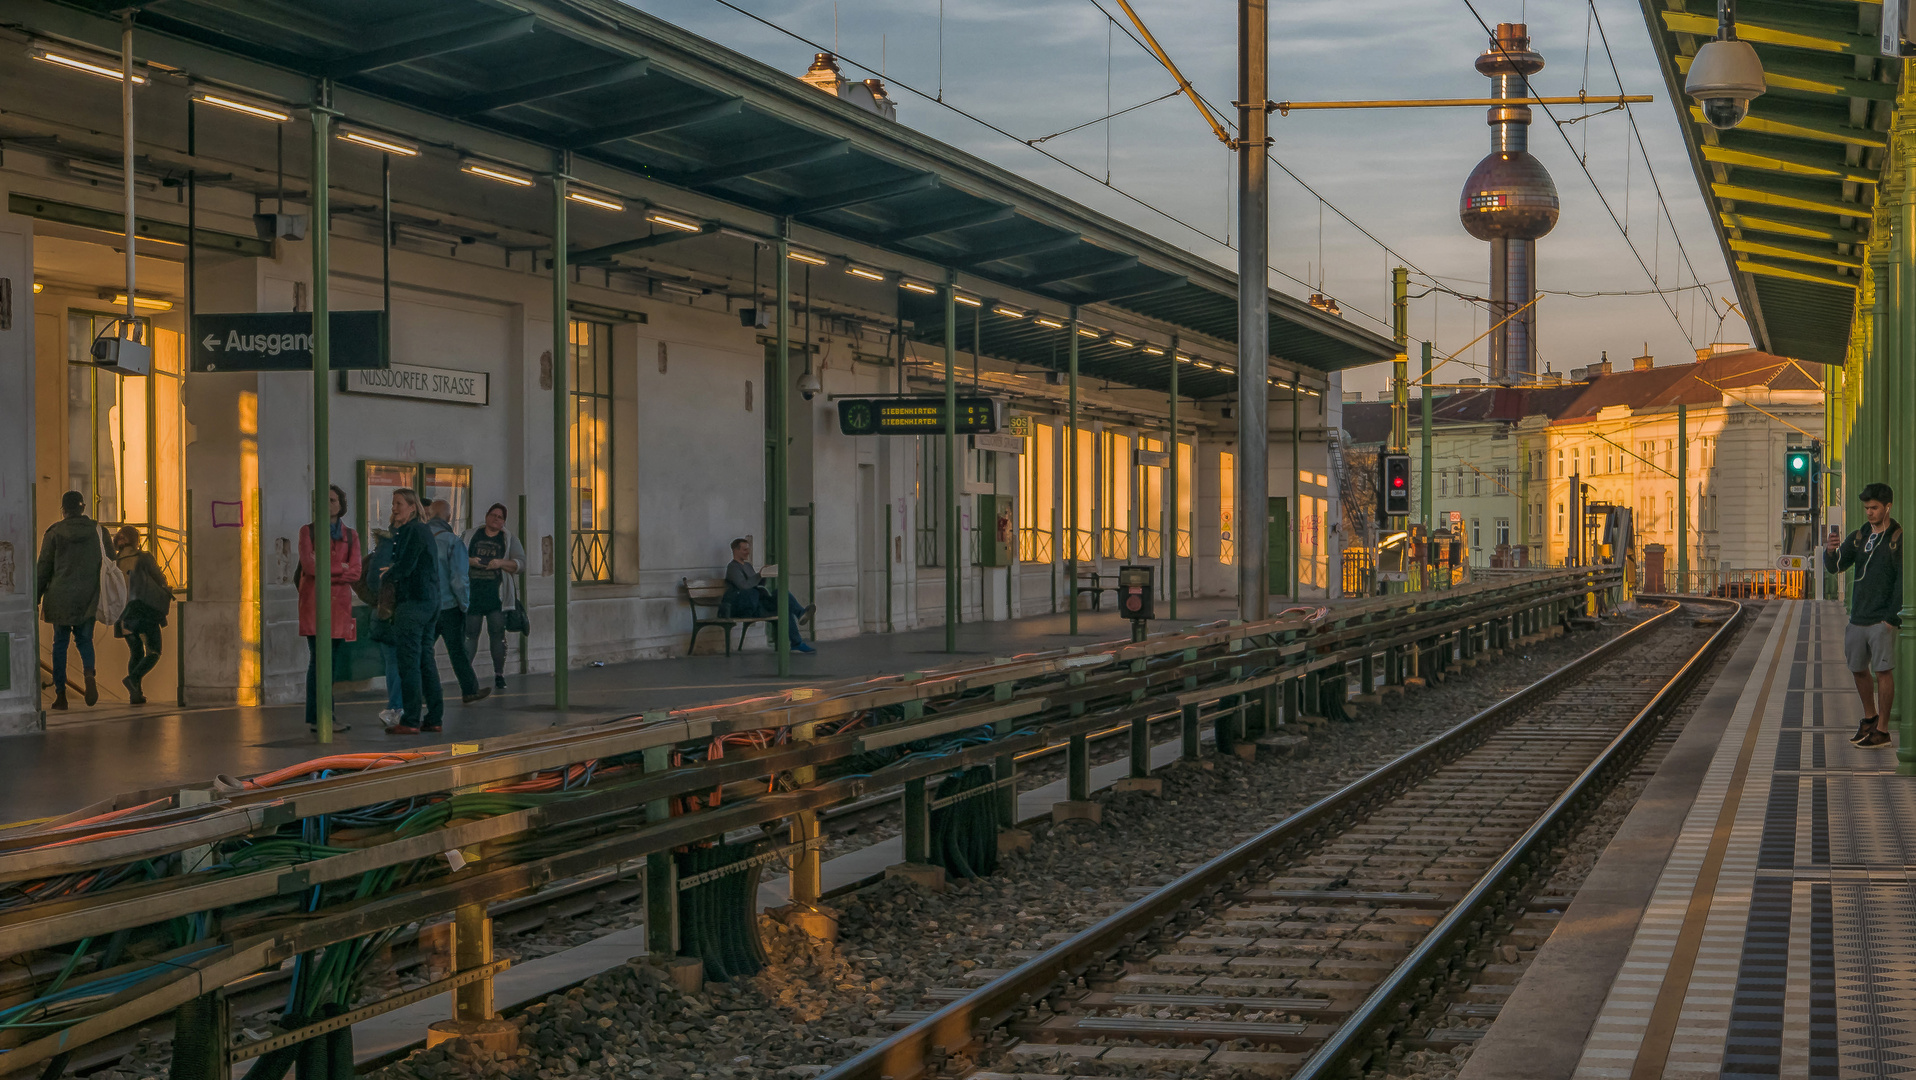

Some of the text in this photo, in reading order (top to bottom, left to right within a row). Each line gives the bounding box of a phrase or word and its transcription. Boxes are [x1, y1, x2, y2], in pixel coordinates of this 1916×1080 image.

[432, 374, 476, 396] STRASSE
[881, 407, 937, 415] SIEBENHIRTEN
[968, 406, 974, 414] 6
[881, 417, 974, 426] SIEBENHIRTEN 9
[980, 414, 988, 424] 2
[1010, 418, 1028, 427] SOS
